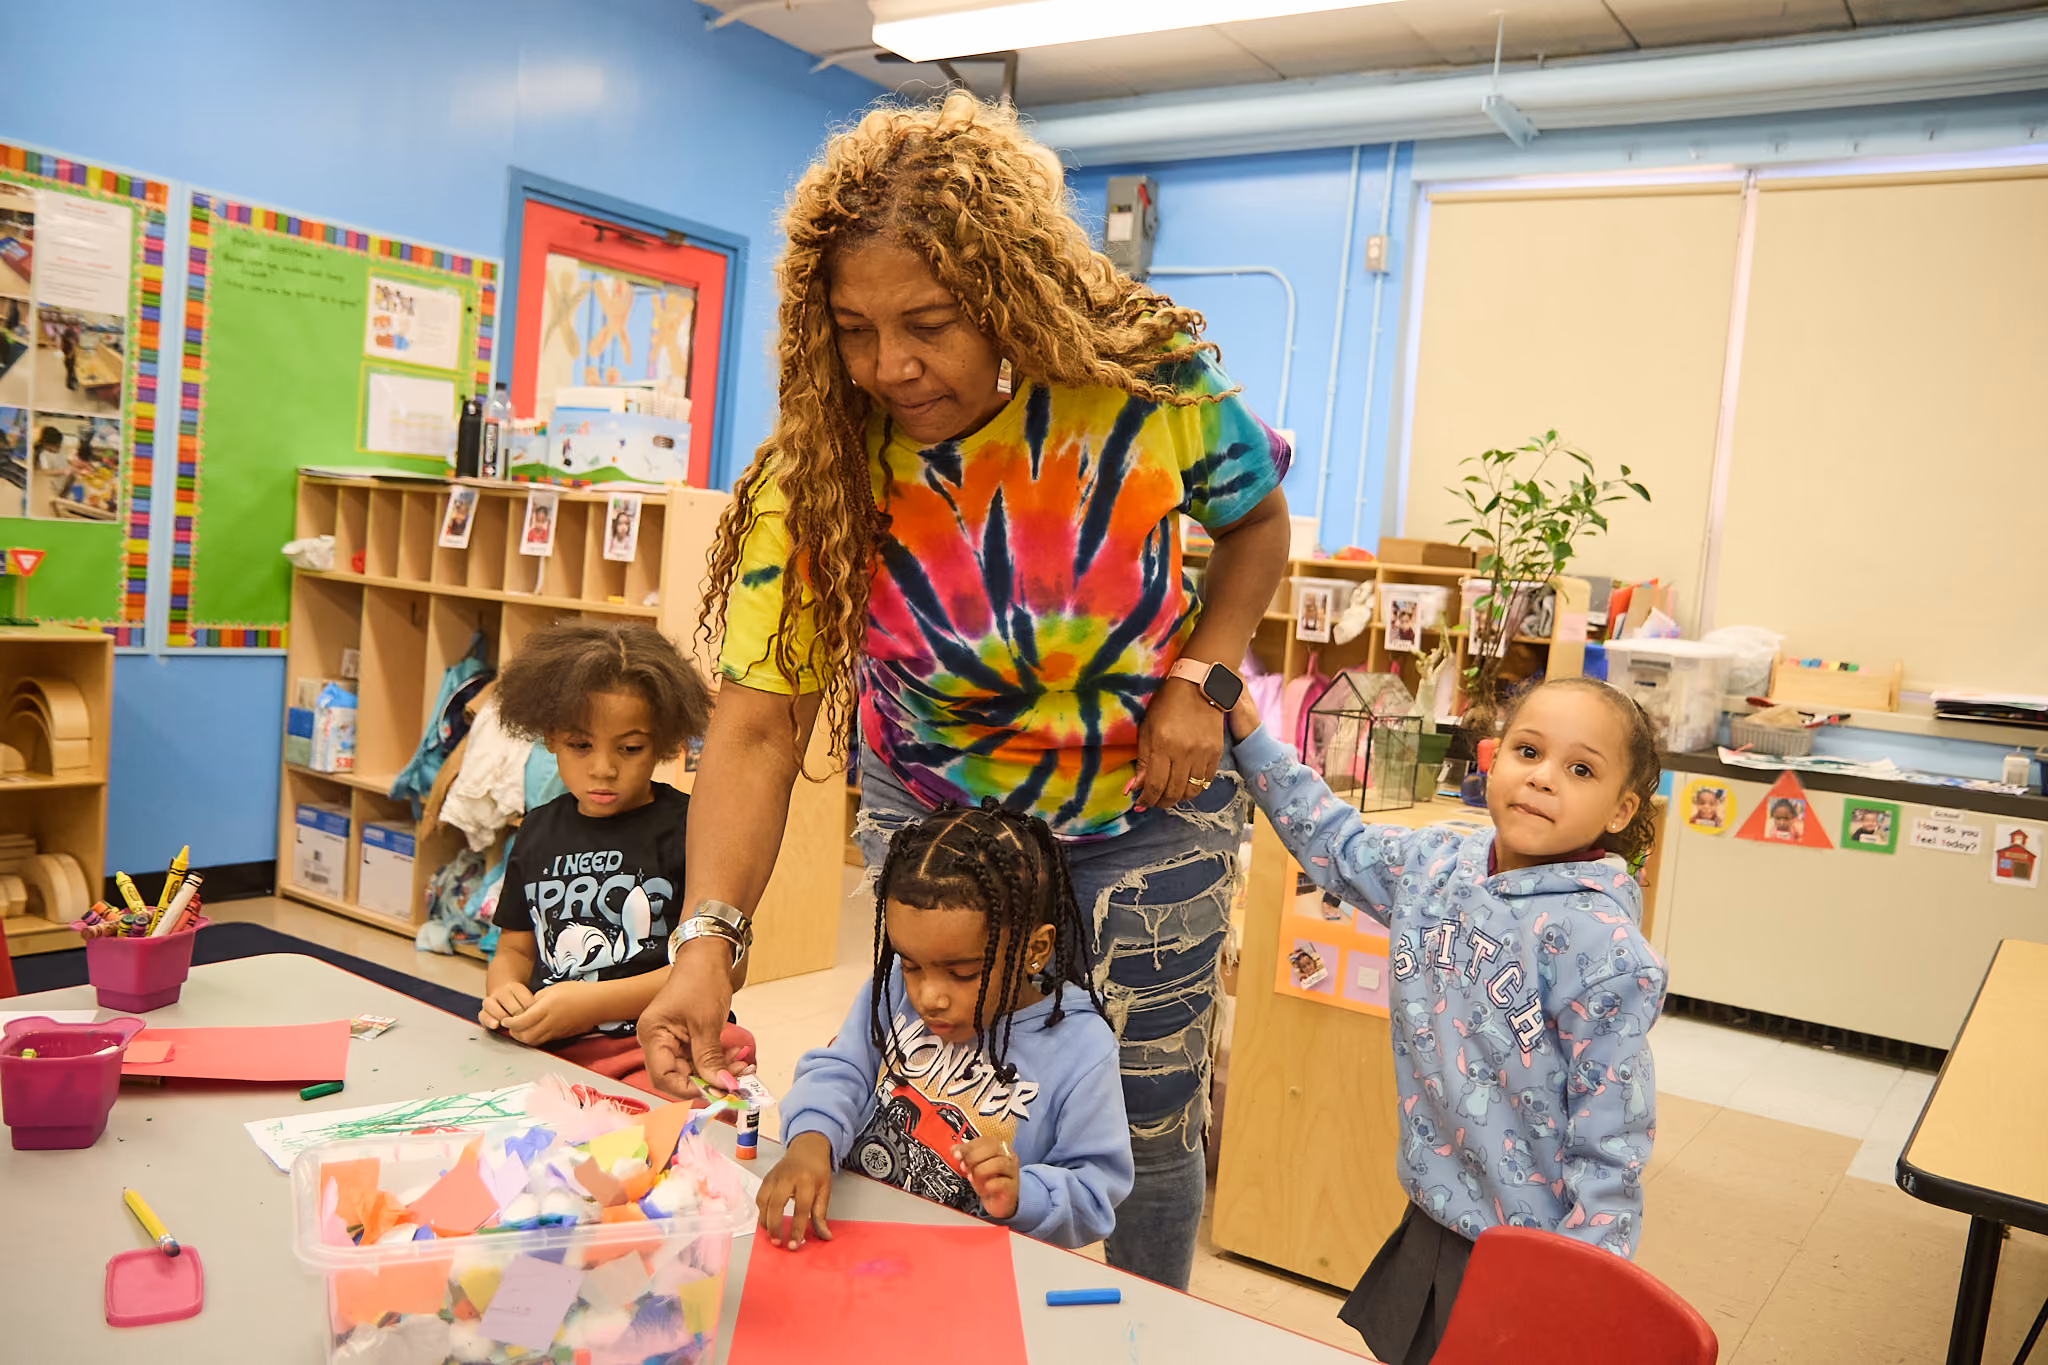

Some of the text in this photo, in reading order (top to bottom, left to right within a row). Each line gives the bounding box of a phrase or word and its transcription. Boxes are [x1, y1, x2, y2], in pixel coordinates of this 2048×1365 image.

[1945, 825, 1956, 834] do
[1961, 830, 1979, 838] you
[552, 850, 623, 877] I NEED
[1395, 918, 1545, 1053] STITCH
